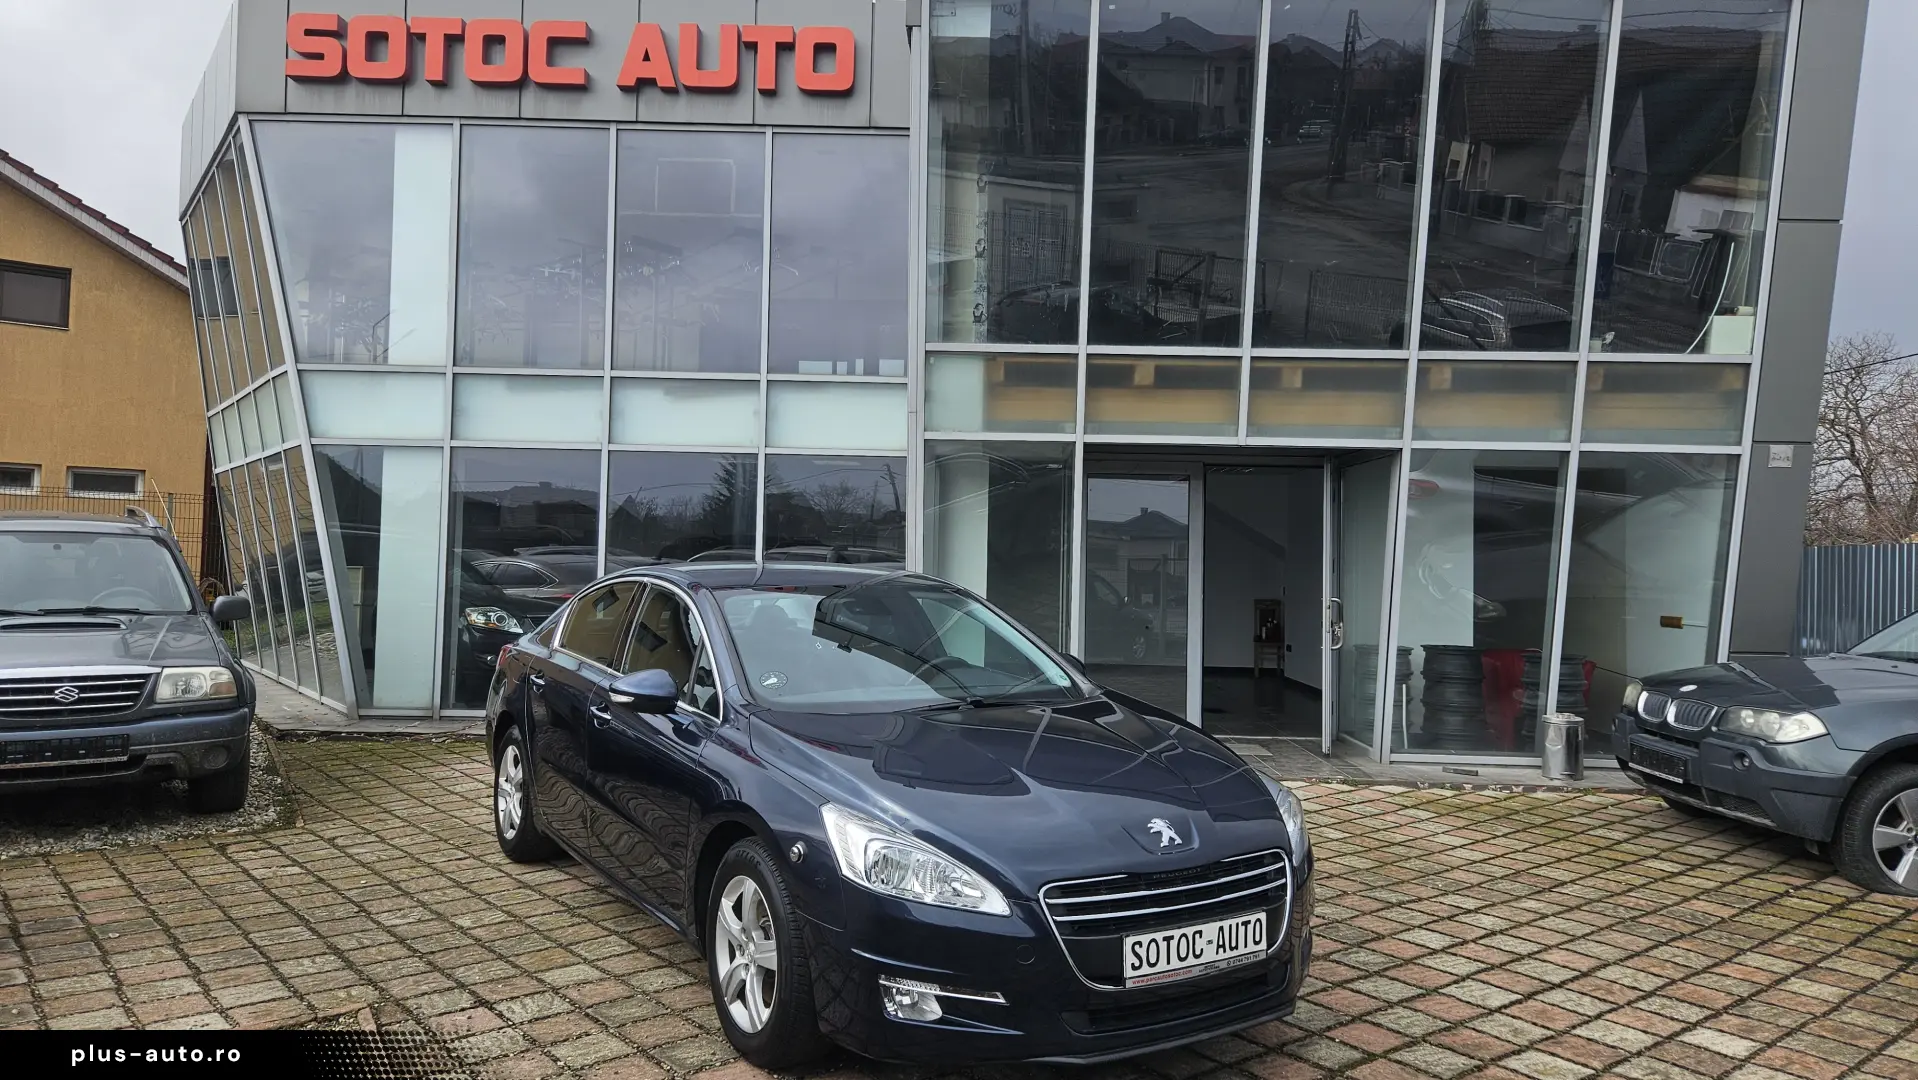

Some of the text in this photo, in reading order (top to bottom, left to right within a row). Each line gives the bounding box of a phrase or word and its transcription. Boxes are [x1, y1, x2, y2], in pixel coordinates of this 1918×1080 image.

[285, 13, 855, 95] SOTOC AUTO
[1130, 917, 1263, 972] SOTOC-AUTO
